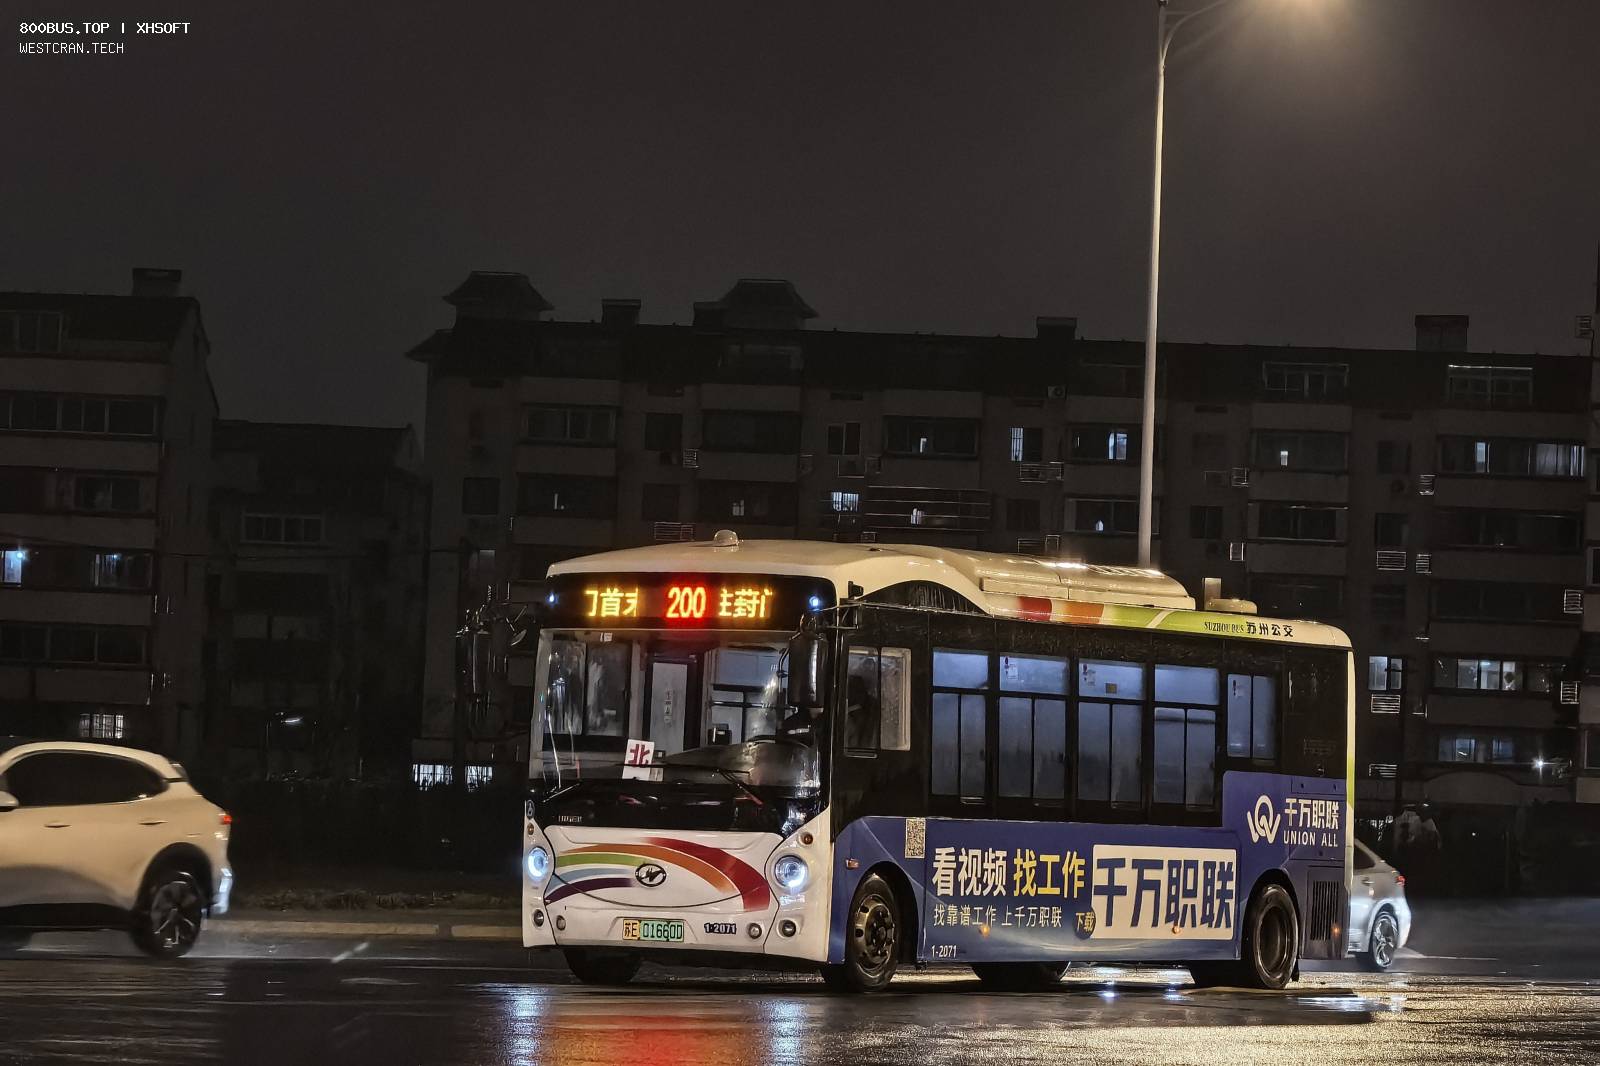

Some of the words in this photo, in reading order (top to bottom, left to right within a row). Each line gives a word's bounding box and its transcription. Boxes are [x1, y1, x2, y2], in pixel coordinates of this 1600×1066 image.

[666, 586, 706, 618] 200
[1246, 621, 1294, 637] 苏州公交
[628, 743, 650, 766] 北
[1284, 798, 1339, 830] 千万职联
[1283, 830, 1316, 846] UNION
[1321, 832, 1338, 847] ALL
[931, 847, 1008, 897] 看视频
[1013, 848, 1086, 899] 找工作
[1093, 857, 1235, 929] 千万职联
[933, 903, 997, 927] 找靠谱工作
[1001, 906, 1062, 928] 上千万职联
[1075, 911, 1095, 933] 下载
[931, 944, 957, 957] 1-2071
